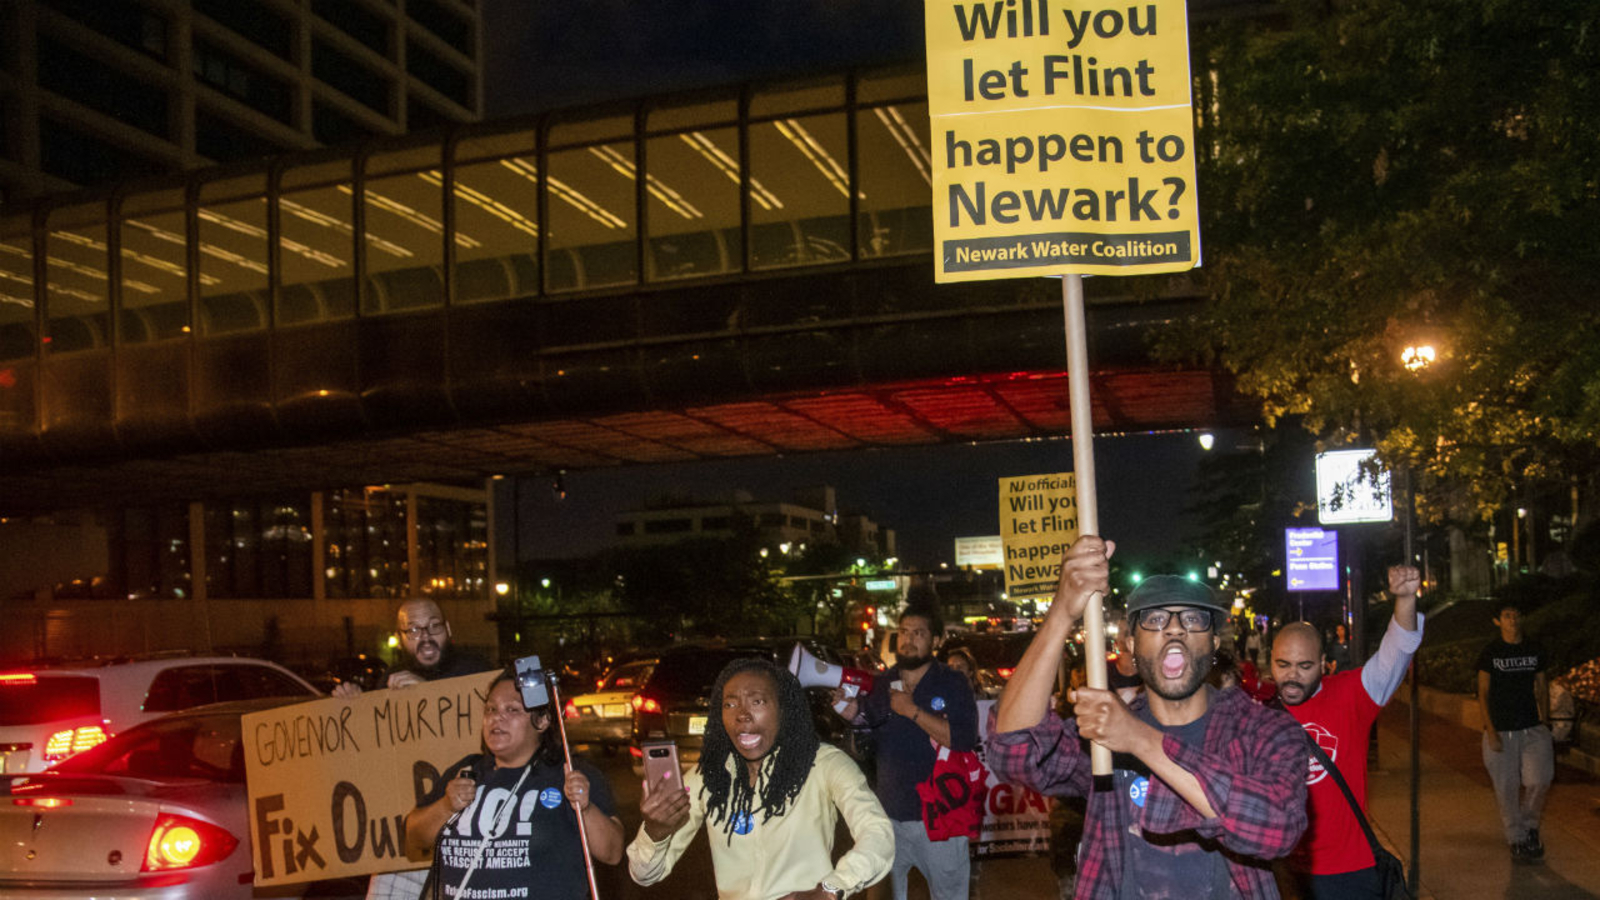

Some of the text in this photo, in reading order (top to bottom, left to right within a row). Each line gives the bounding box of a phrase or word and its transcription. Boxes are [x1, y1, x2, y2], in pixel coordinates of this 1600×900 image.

[954, 0, 1157, 49] Will you
[963, 55, 1156, 101] let Flint
[946, 130, 1185, 174] happen to
[948, 177, 1186, 228] Newark?
[956, 240, 1177, 263] Newark Water Coalition
[1009, 481, 1026, 493] NJ
[1010, 494, 1043, 512] Will
[1012, 518, 1037, 534] let
[1009, 564, 1061, 581] Newa
[255, 706, 360, 766] GOVENOR
[255, 793, 327, 879] Fix
[485, 856, 531, 869] AMERICA
[497, 848, 529, 857] ACCEPT
